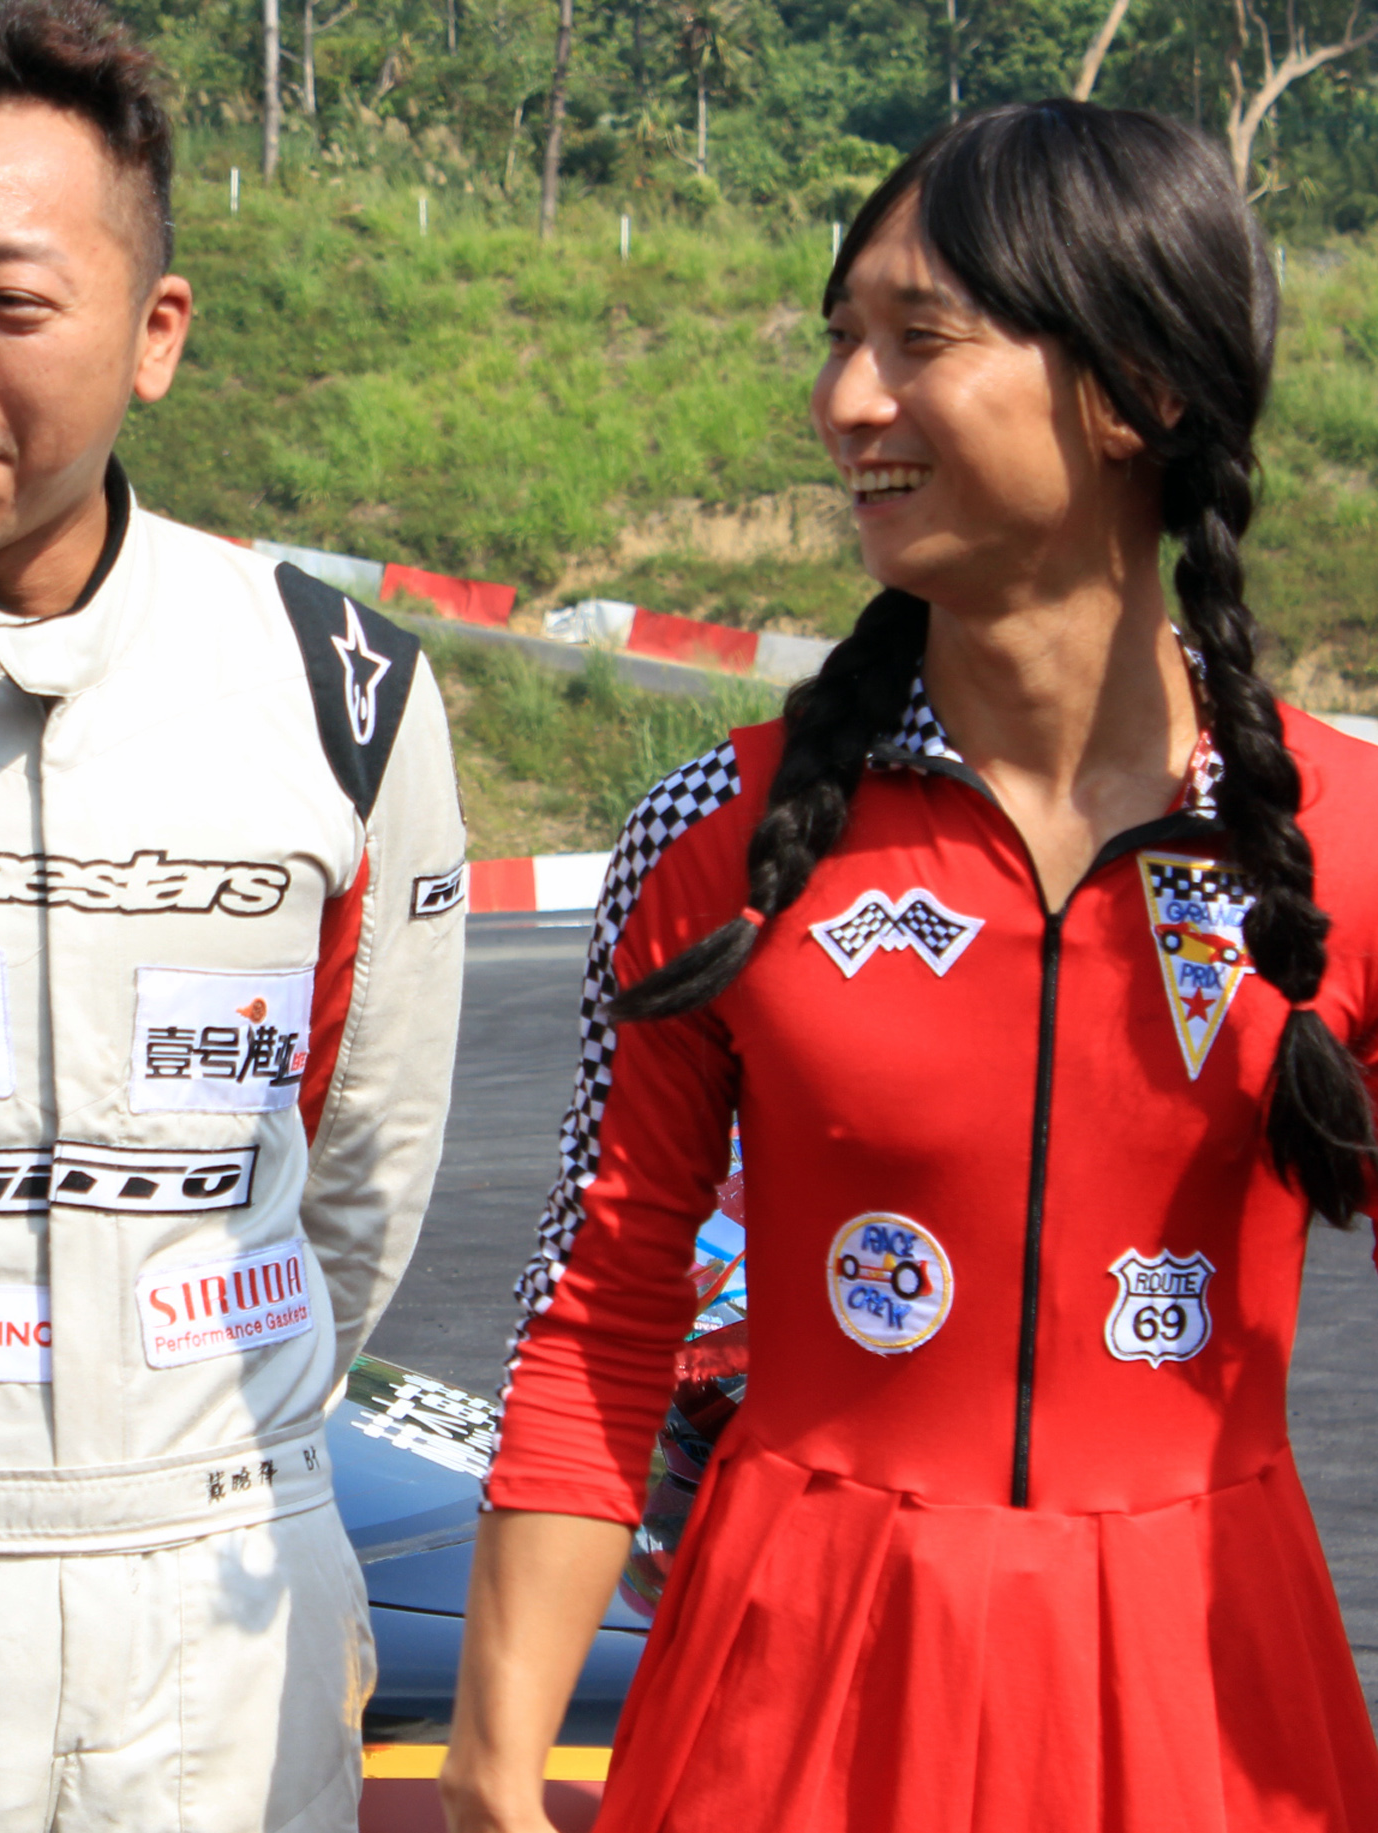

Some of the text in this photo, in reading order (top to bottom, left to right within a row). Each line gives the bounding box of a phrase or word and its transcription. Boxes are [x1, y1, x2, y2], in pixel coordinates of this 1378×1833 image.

[1180, 962, 1227, 990] PRIX
[861, 1225, 919, 1258] RACE
[149, 1256, 303, 1329] SIRUDA
[1135, 1272, 1199, 1293] ROUTE
[848, 1286, 914, 1331] CREW
[1133, 1304, 1187, 1342] 69
[155, 1305, 309, 1354] Performance Gaskets
